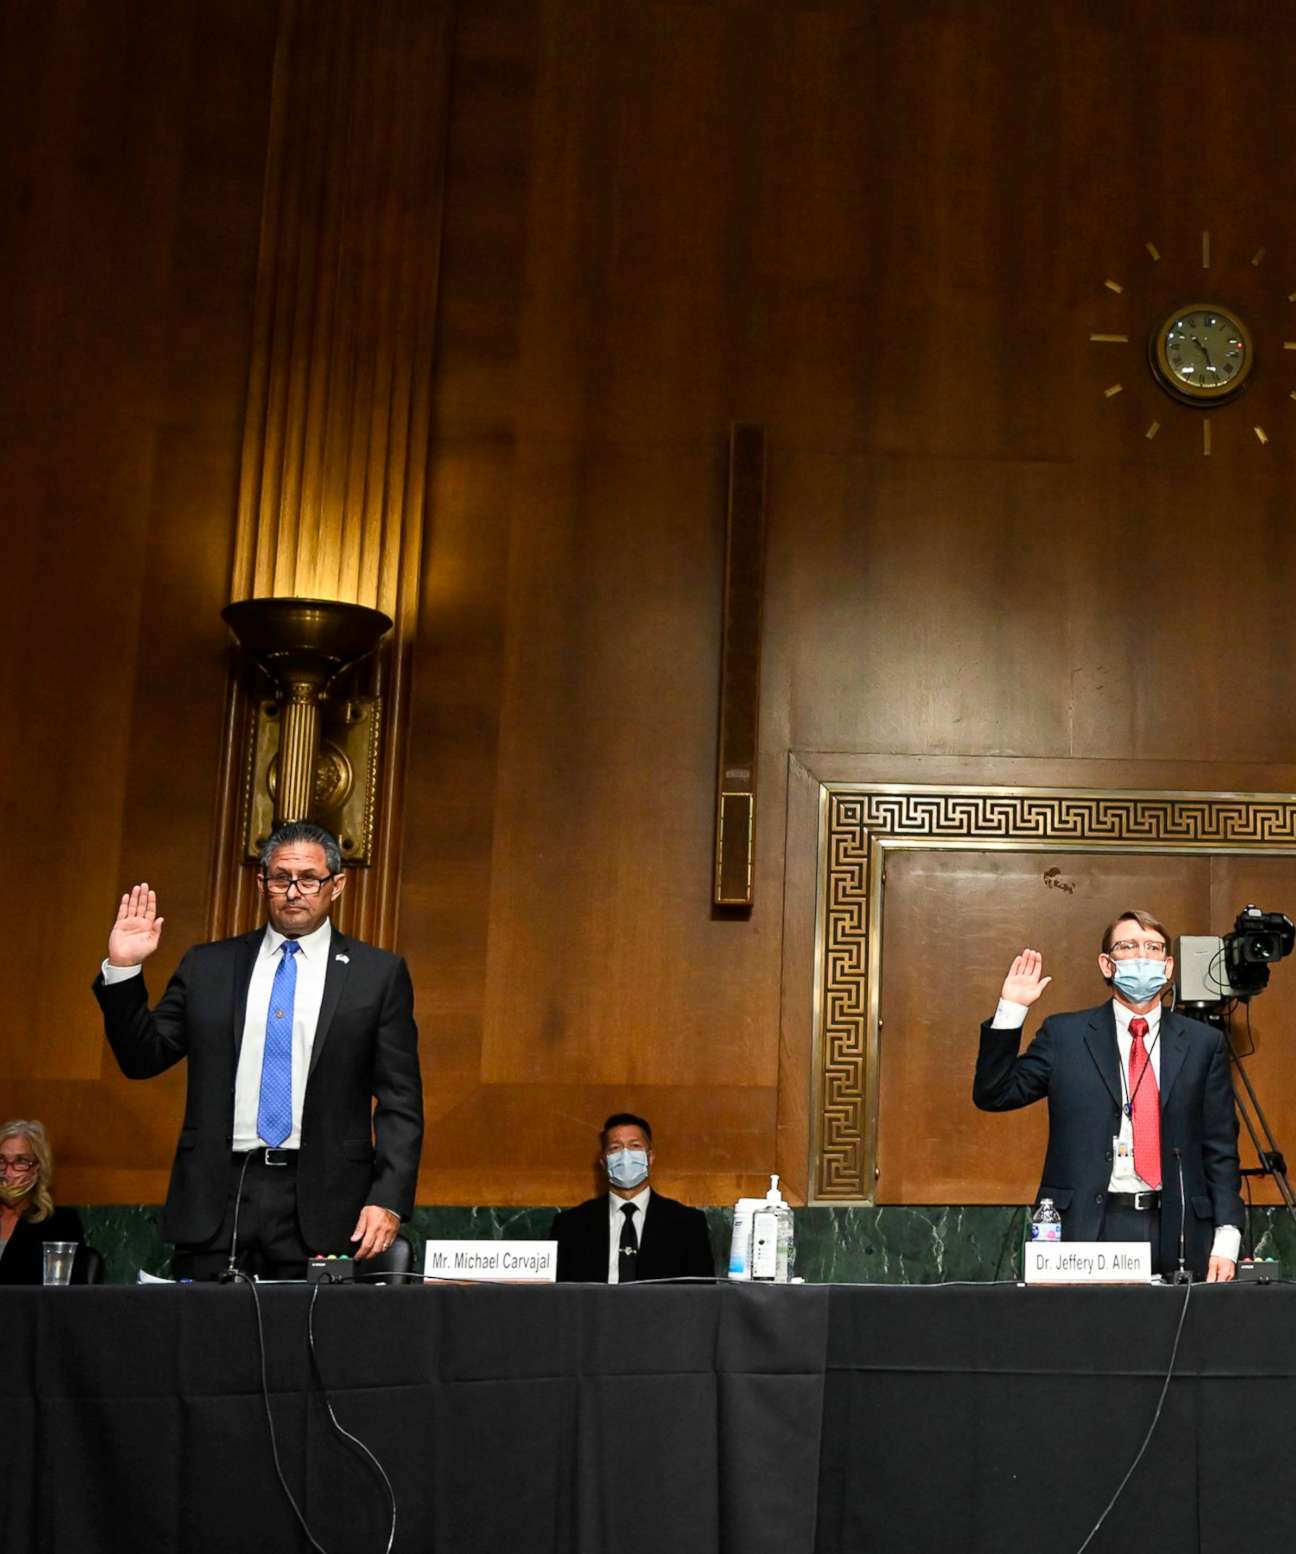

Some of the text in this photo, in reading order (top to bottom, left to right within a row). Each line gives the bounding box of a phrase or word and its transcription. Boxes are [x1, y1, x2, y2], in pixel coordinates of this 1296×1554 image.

[432, 1252, 550, 1273] Mr. Michael Carvajal
[1056, 1254, 1093, 1274] Jeffery
[1112, 1254, 1141, 1270] Allen
